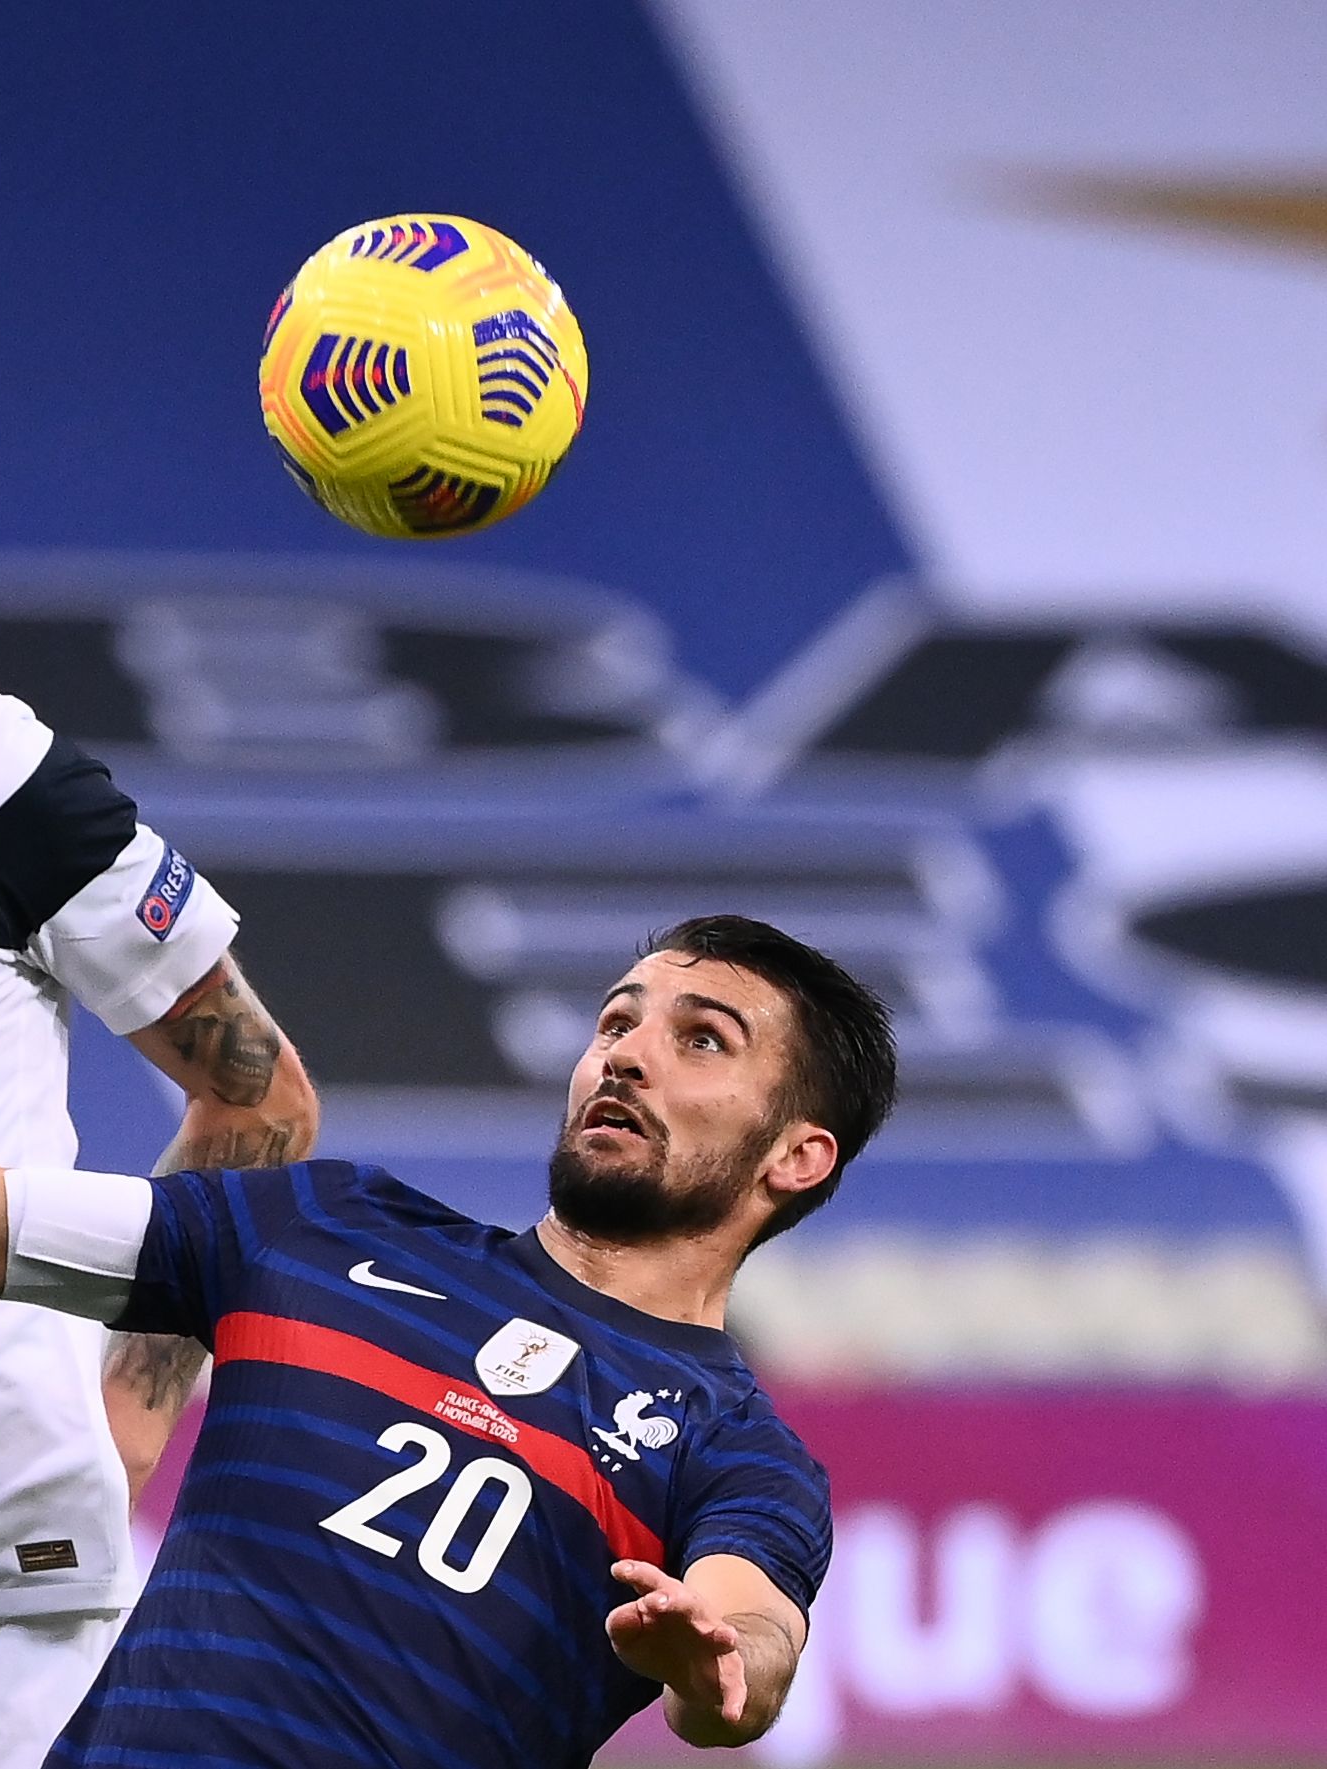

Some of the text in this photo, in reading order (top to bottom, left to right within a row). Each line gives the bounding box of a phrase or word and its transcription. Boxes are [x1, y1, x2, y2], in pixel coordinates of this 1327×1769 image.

[495, 1364, 525, 1383] FIFA
[488, 1421, 518, 1443] 2020
[317, 1421, 533, 1594] 20
